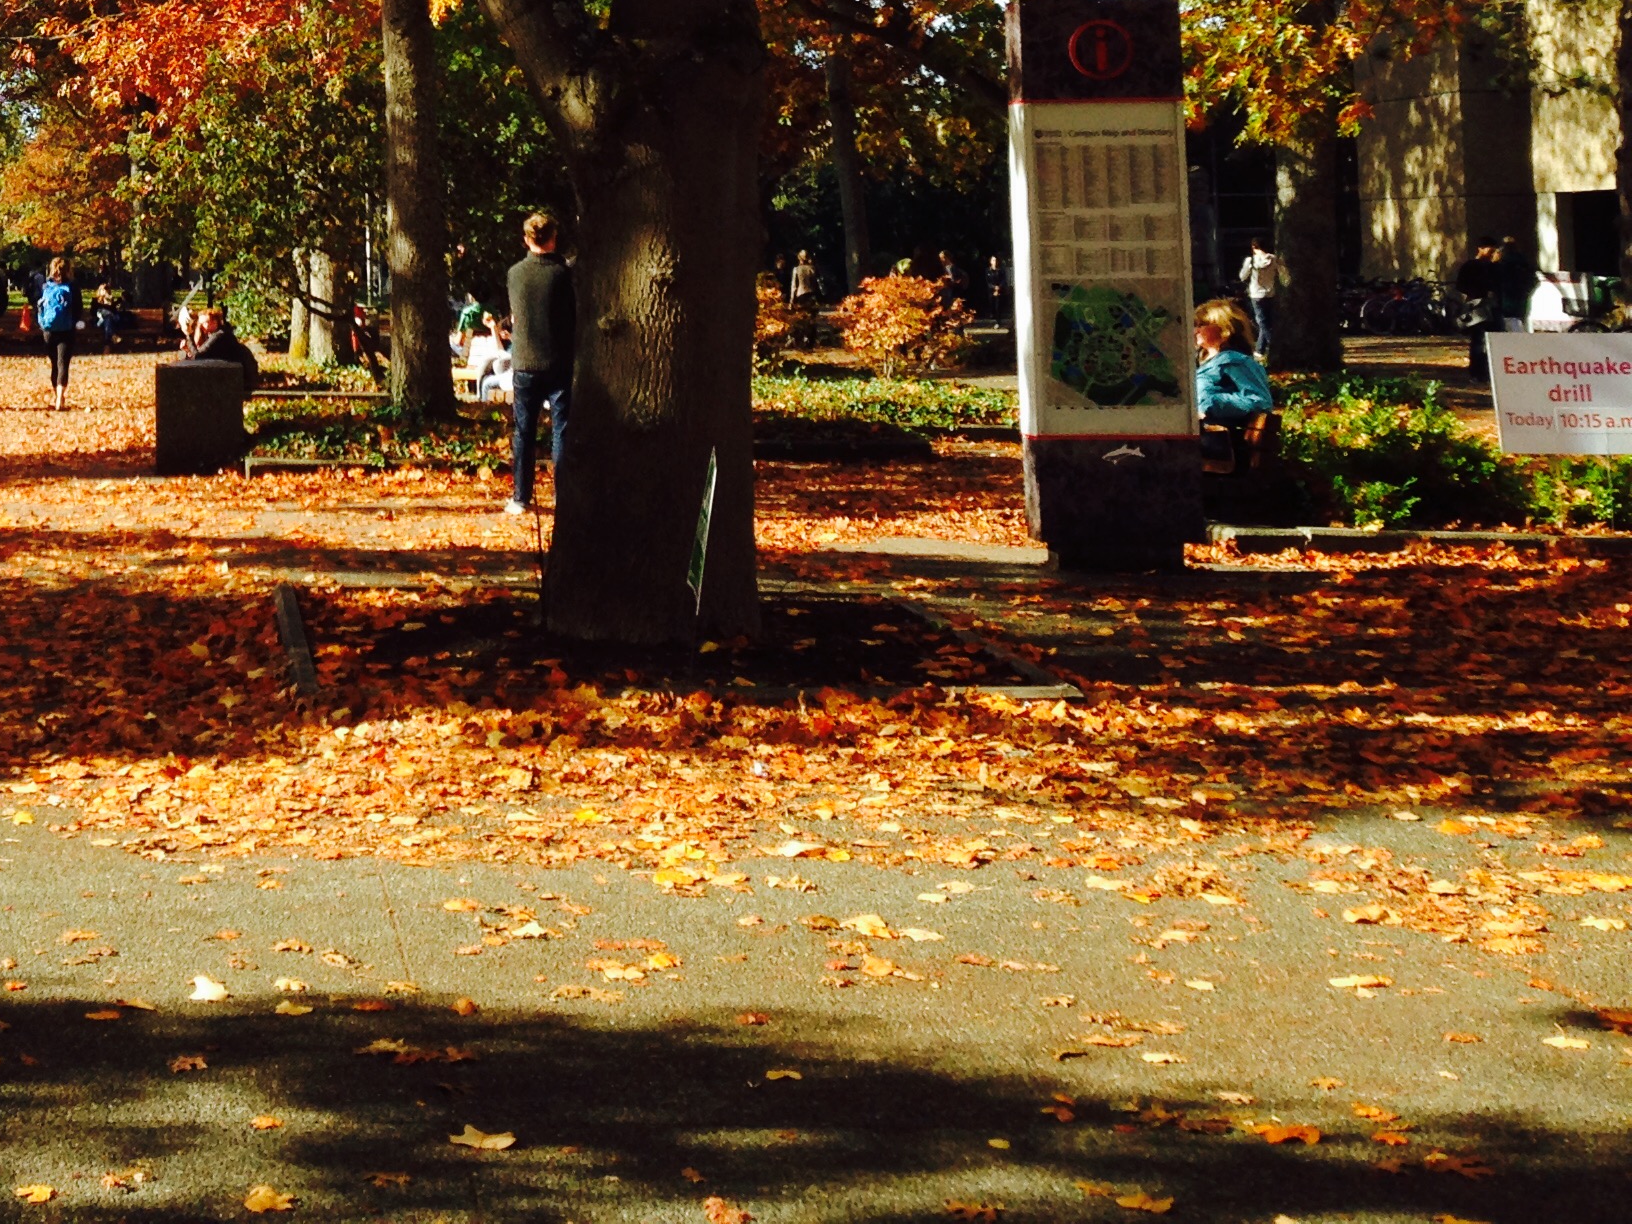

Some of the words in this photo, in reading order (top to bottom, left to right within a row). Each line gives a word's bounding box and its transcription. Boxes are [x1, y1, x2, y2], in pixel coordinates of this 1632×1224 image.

[1502, 356, 1632, 380] Earthquake
[1548, 383, 1593, 403] drill
[1504, 412, 1554, 429] Today
[1559, 413, 1602, 429] 10:15
